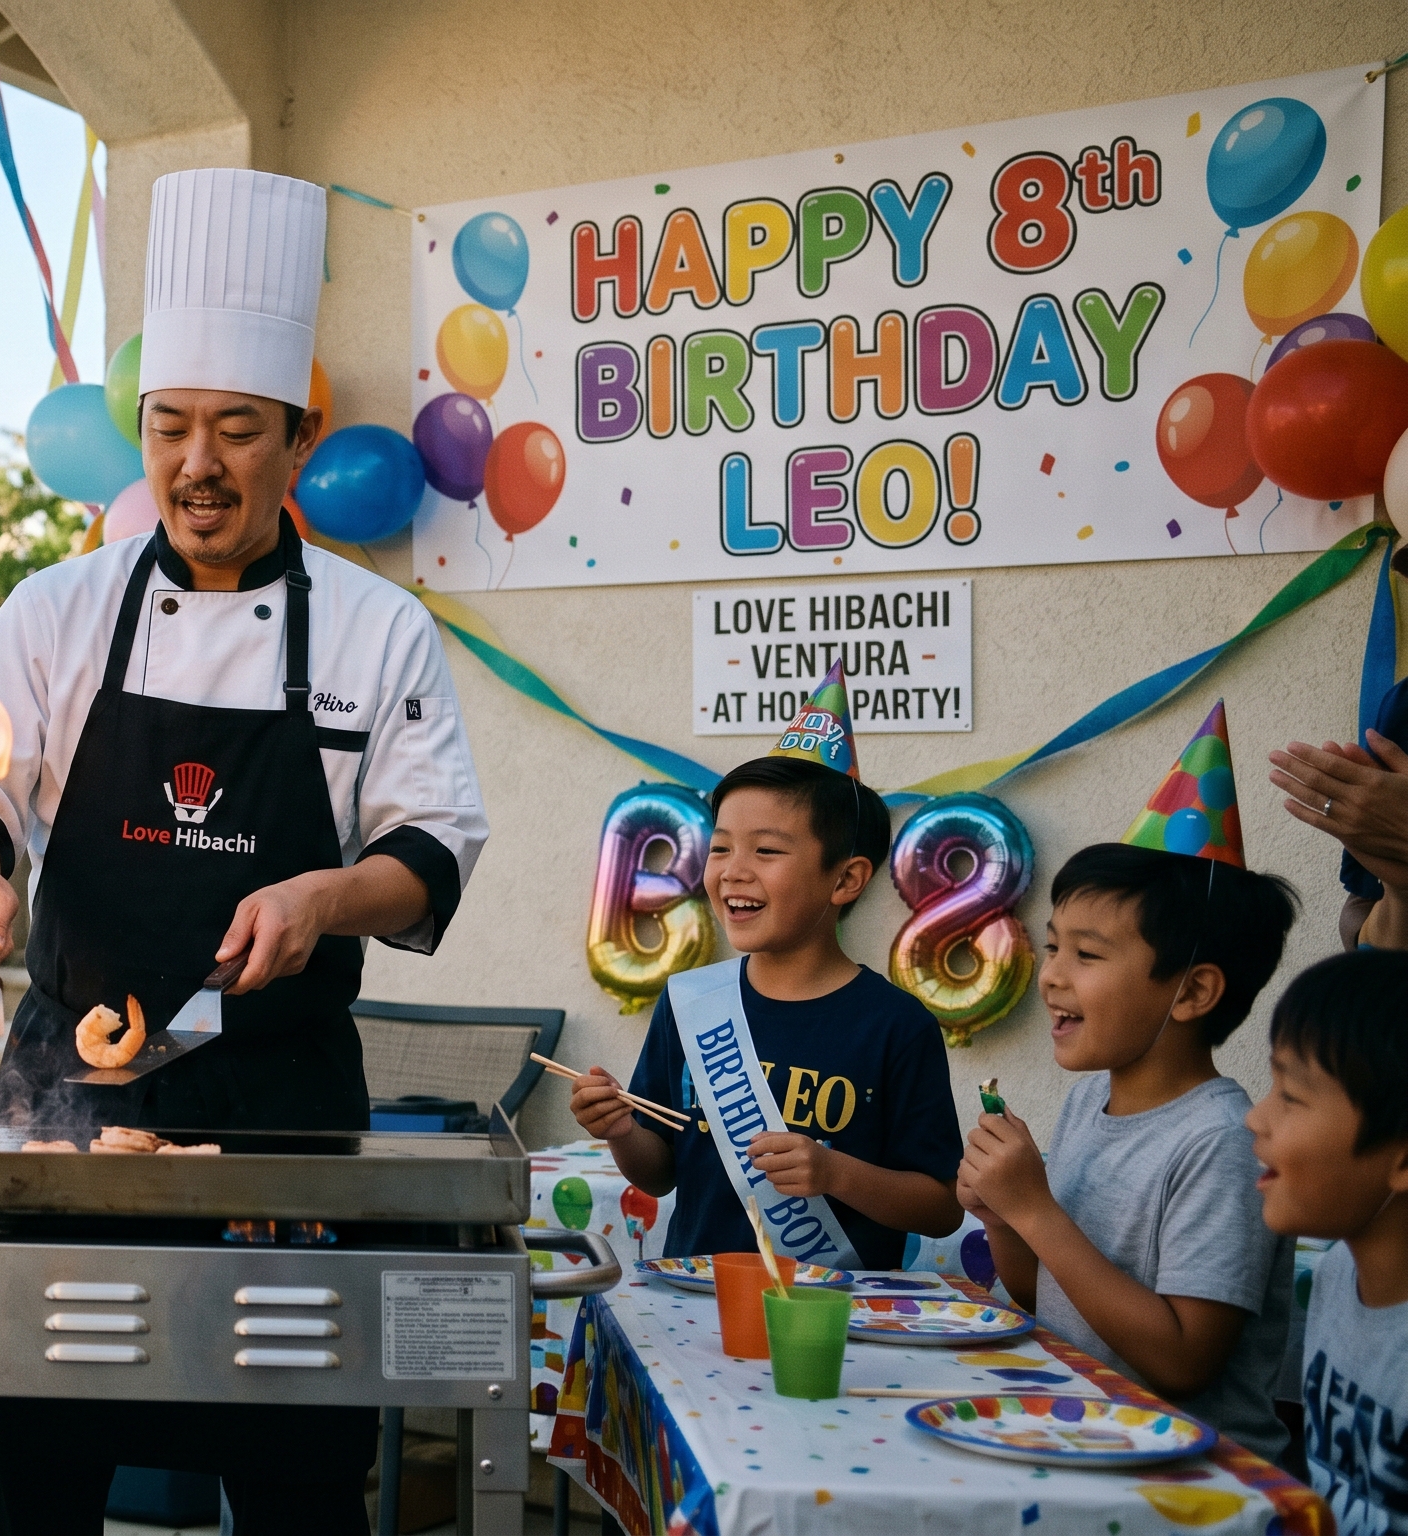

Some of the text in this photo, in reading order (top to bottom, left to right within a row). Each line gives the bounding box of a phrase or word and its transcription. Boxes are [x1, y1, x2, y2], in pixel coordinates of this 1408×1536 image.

[571, 135, 1161, 322] HAPPY 8th
[574, 282, 1165, 445] BIRTHDAY
[719, 432, 982, 557] LEO!
[714, 591, 950, 635] LOVE HIBACHI
[751, 640, 911, 679] VENTURA
[312, 692, 359, 714] Hiro
[712, 692, 747, 723] AT
[853, 688, 960, 720] PARTY!
[122, 819, 257, 854] Love Hibachi
[889, 791, 1035, 1034] 8
[761, 1060, 857, 1133] EO
[763, 1197, 839, 1263] BOY
